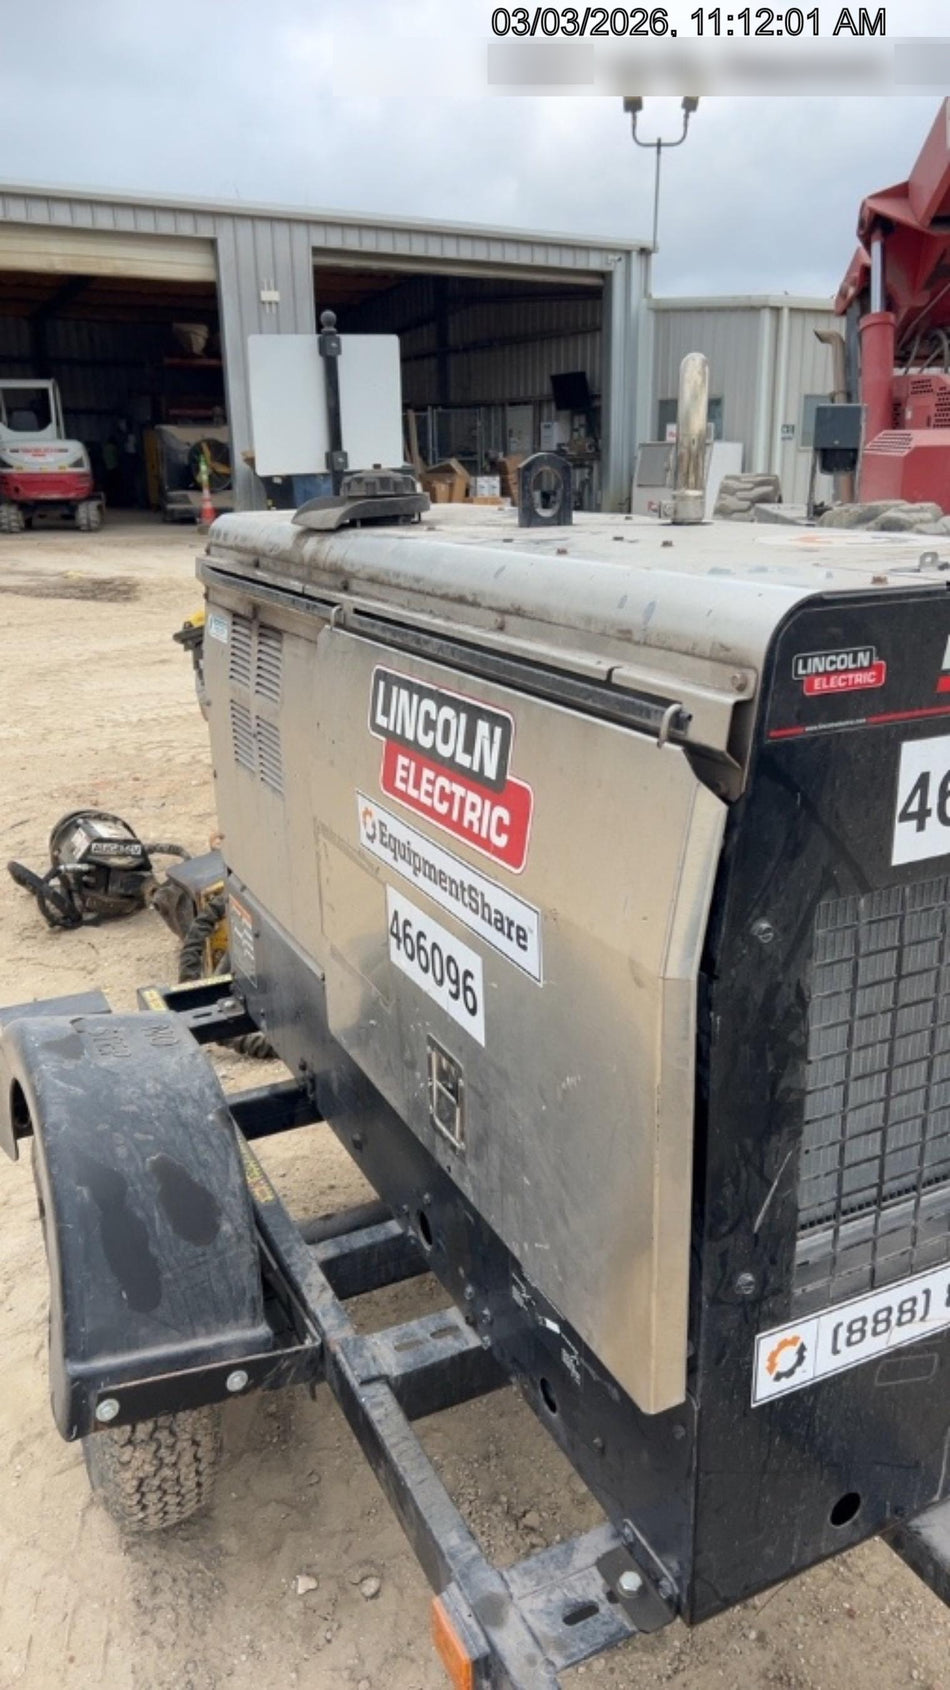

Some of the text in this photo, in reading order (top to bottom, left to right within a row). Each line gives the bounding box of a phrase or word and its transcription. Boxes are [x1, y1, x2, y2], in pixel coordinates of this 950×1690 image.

[797, 650, 871, 675] LINCOLN
[813, 670, 877, 690] ELECTRIC
[374, 680, 503, 782] LINCOLN
[393, 753, 511, 849] ELECTRIC
[377, 820, 530, 953] EquipmentShare
[389, 909, 479, 1018] 466096
[830, 1287, 932, 1356] (888)
